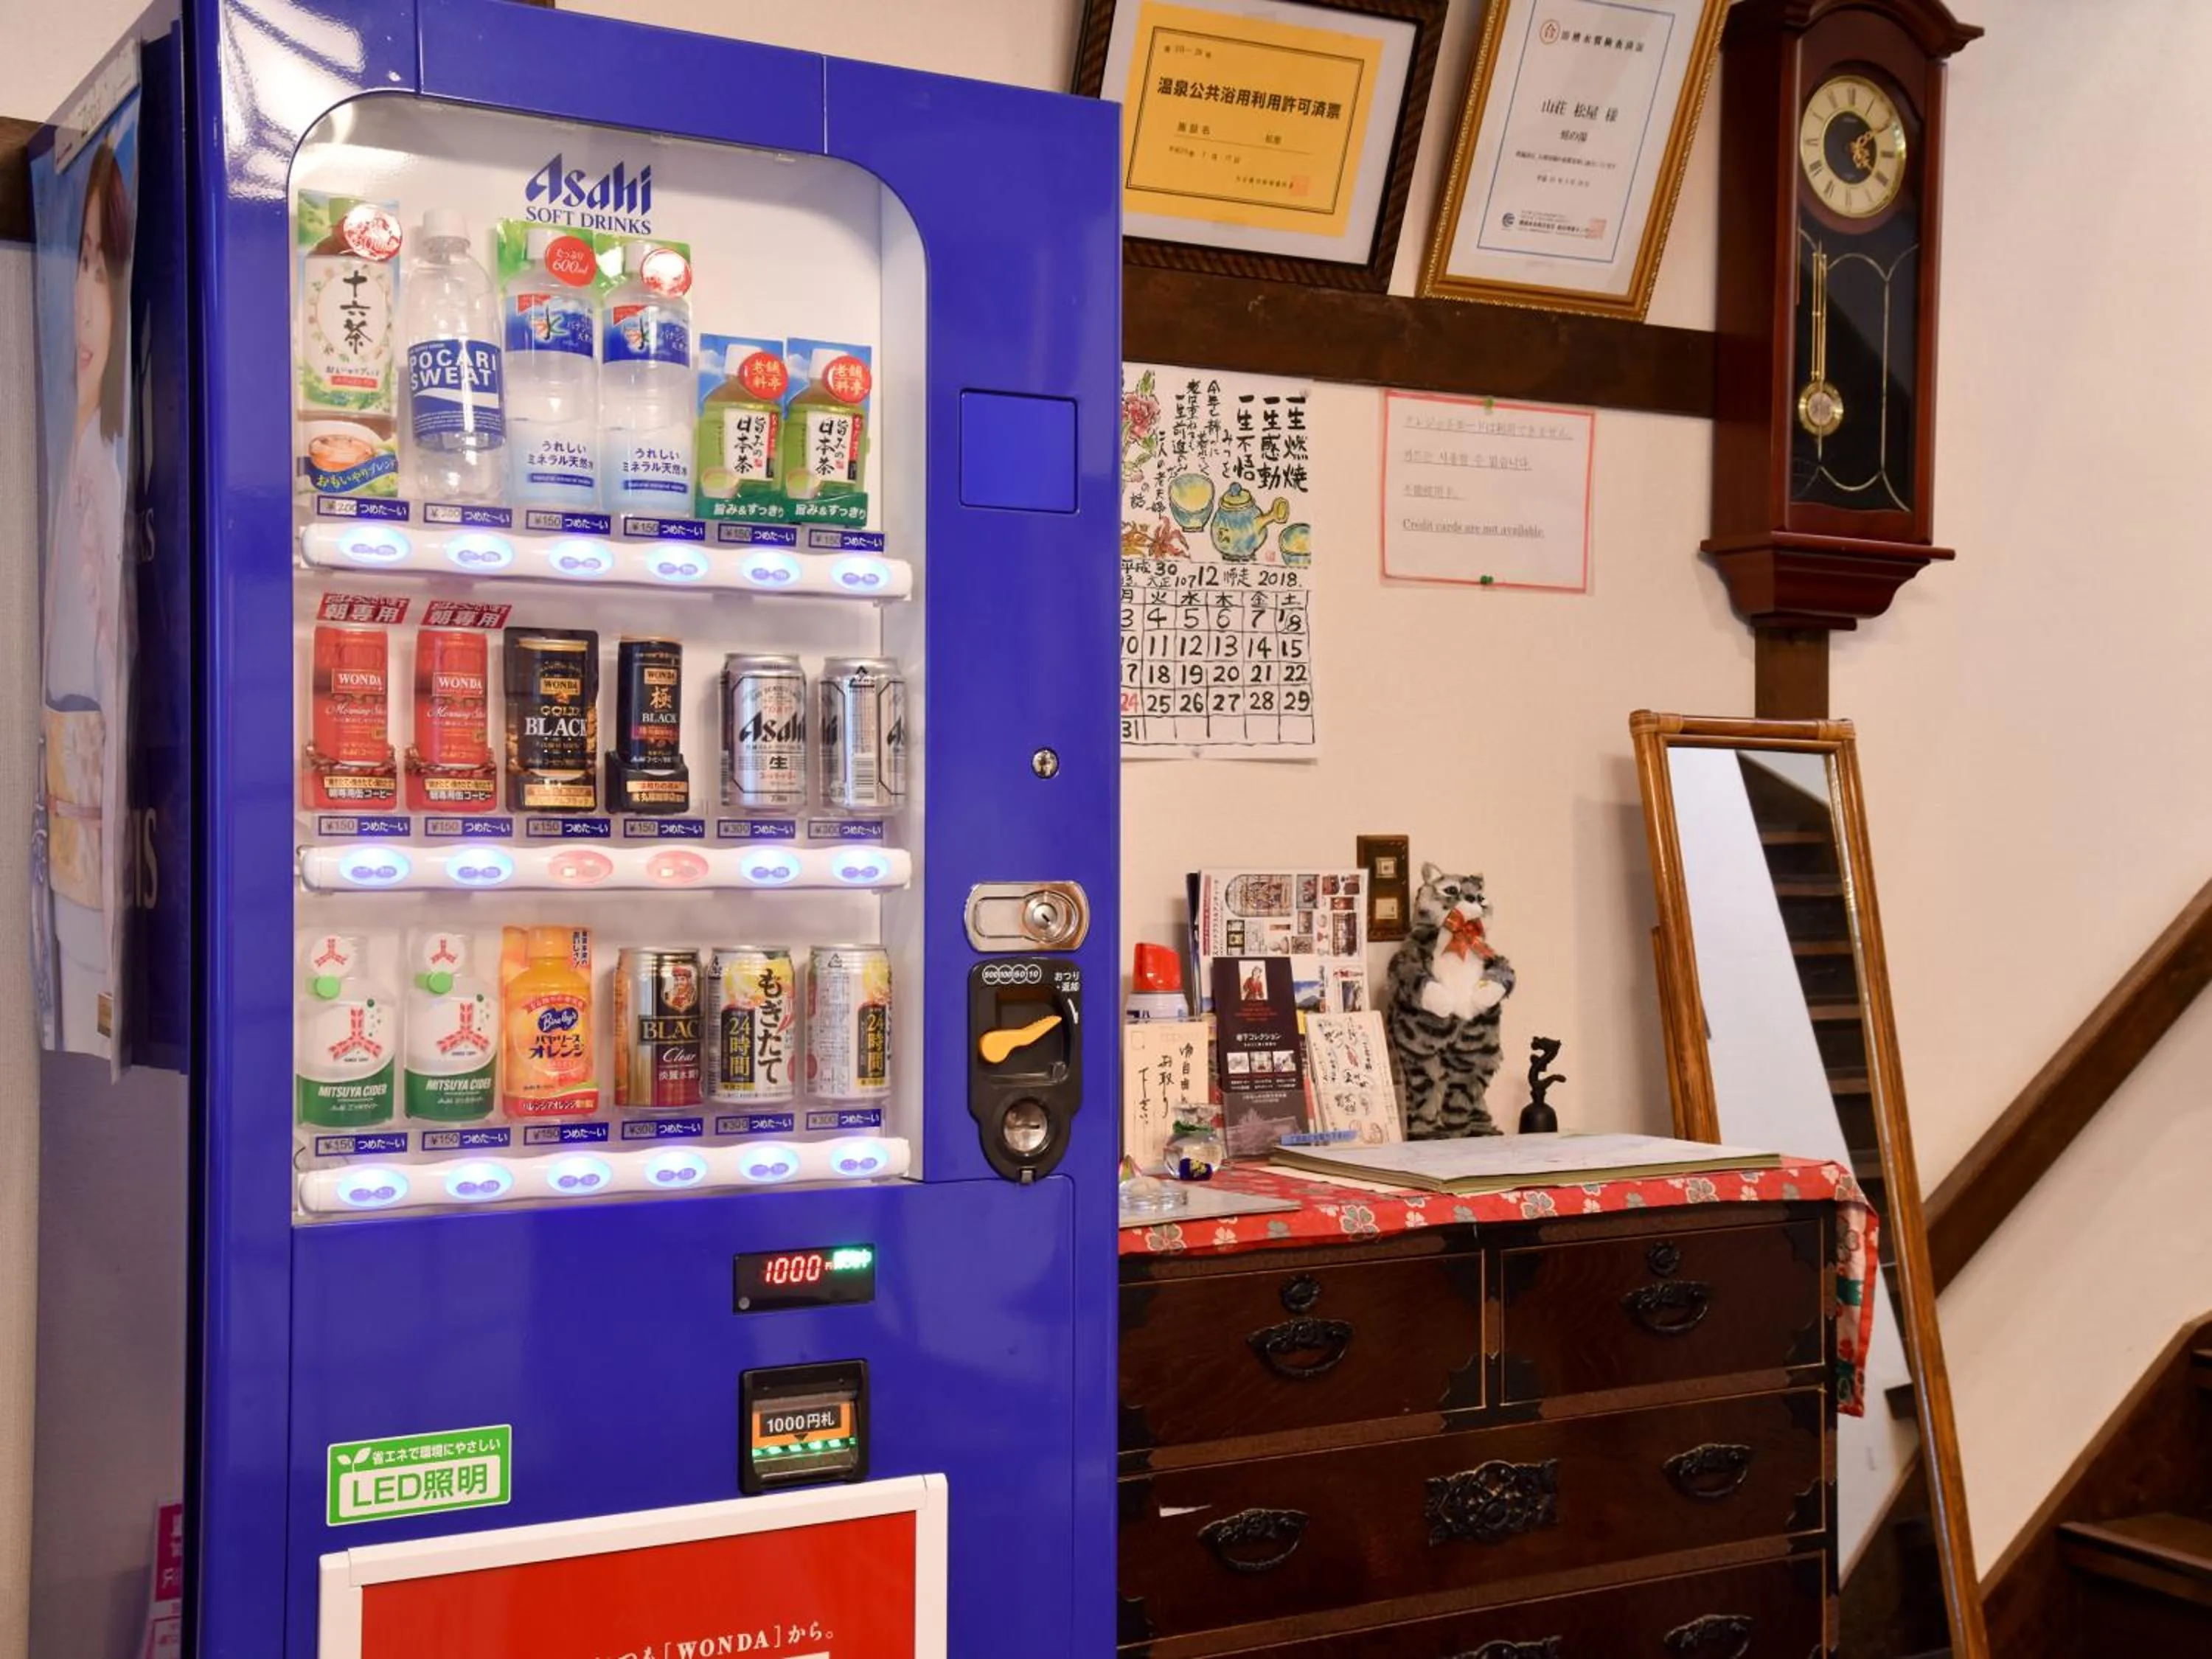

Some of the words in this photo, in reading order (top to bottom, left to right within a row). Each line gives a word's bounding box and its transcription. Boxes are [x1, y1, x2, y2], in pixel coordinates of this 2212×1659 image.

[1157, 76, 1343, 120] 温泉公共浴用利用許可済票
[525, 153, 652, 215] Asahi
[526, 206, 577, 226] SOFT
[580, 212, 652, 236] DRINKS
[340, 270, 372, 355] 十六茶
[410, 349, 497, 369] POCARI
[411, 367, 492, 391] SWEAT
[542, 441, 586, 453] うれしい
[734, 415, 753, 474] 日本茶
[815, 420, 835, 476] 日本茶
[1233, 394, 1256, 481] 一生不悟
[1256, 396, 1281, 490] 一生感動
[1282, 397, 1309, 493] 一生燃焼
[636, 448, 680, 460] うれしい
[1402, 518, 1433, 531] Credit
[1436, 521, 1462, 533] cards
[1198, 566, 1219, 587] 12
[1223, 568, 1251, 588] 師走
[1151, 591, 1167, 604] 火
[1180, 590, 1201, 605] 水
[1215, 592, 1233, 607] 木
[1251, 591, 1268, 607] 金
[1281, 593, 1300, 606] 土
[324, 604, 399, 622] 朝専用
[428, 611, 499, 628] 朝専用
[1121, 608, 1133, 627] 3
[1147, 608, 1166, 629] 4
[1184, 608, 1199, 627] 5
[1217, 608, 1231, 627] 6
[1251, 609, 1266, 628] 7
[1150, 635, 1167, 657] 11
[1180, 635, 1203, 657] 12
[1215, 635, 1238, 657] 13
[1248, 636, 1272, 659] 14
[1281, 639, 1302, 658] 15
[338, 672, 382, 686] WONDA
[439, 676, 483, 689] WONDA
[543, 680, 579, 690] WONDA
[1149, 664, 1170, 684] 18
[1181, 664, 1203, 685] 19
[1213, 665, 1239, 682] 20
[1251, 664, 1271, 683] 21
[1284, 664, 1307, 681] 22
[540, 706, 581, 717] GOLD
[1147, 695, 1171, 714] 25
[1180, 692, 1203, 713] 26
[1213, 694, 1240, 712] 27
[1250, 691, 1274, 710] 28
[1284, 691, 1310, 711] 29
[642, 713, 677, 723] BLACK
[1121, 719, 1138, 740] 31
[769, 757, 787, 769] 生
[1054, 971, 1079, 981] おつり
[643, 1020, 698, 1040] BLAC
[757, 968, 782, 1085] もぎたて
[535, 1034, 580, 1044] バヤリース
[529, 1043, 585, 1059] オレンジ
[663, 1046, 696, 1062] Clear
[318, 1085, 362, 1098] MITSUYA
[363, 1083, 387, 1096] CIDER
[425, 1078, 468, 1091] MITSUYA
[765, 1254, 821, 1284] 1000
[766, 1411, 835, 1433] 1000円札
[372, 1439, 501, 1465] 省エネで環境にやさしい
[352, 1463, 487, 1508] LED照明
